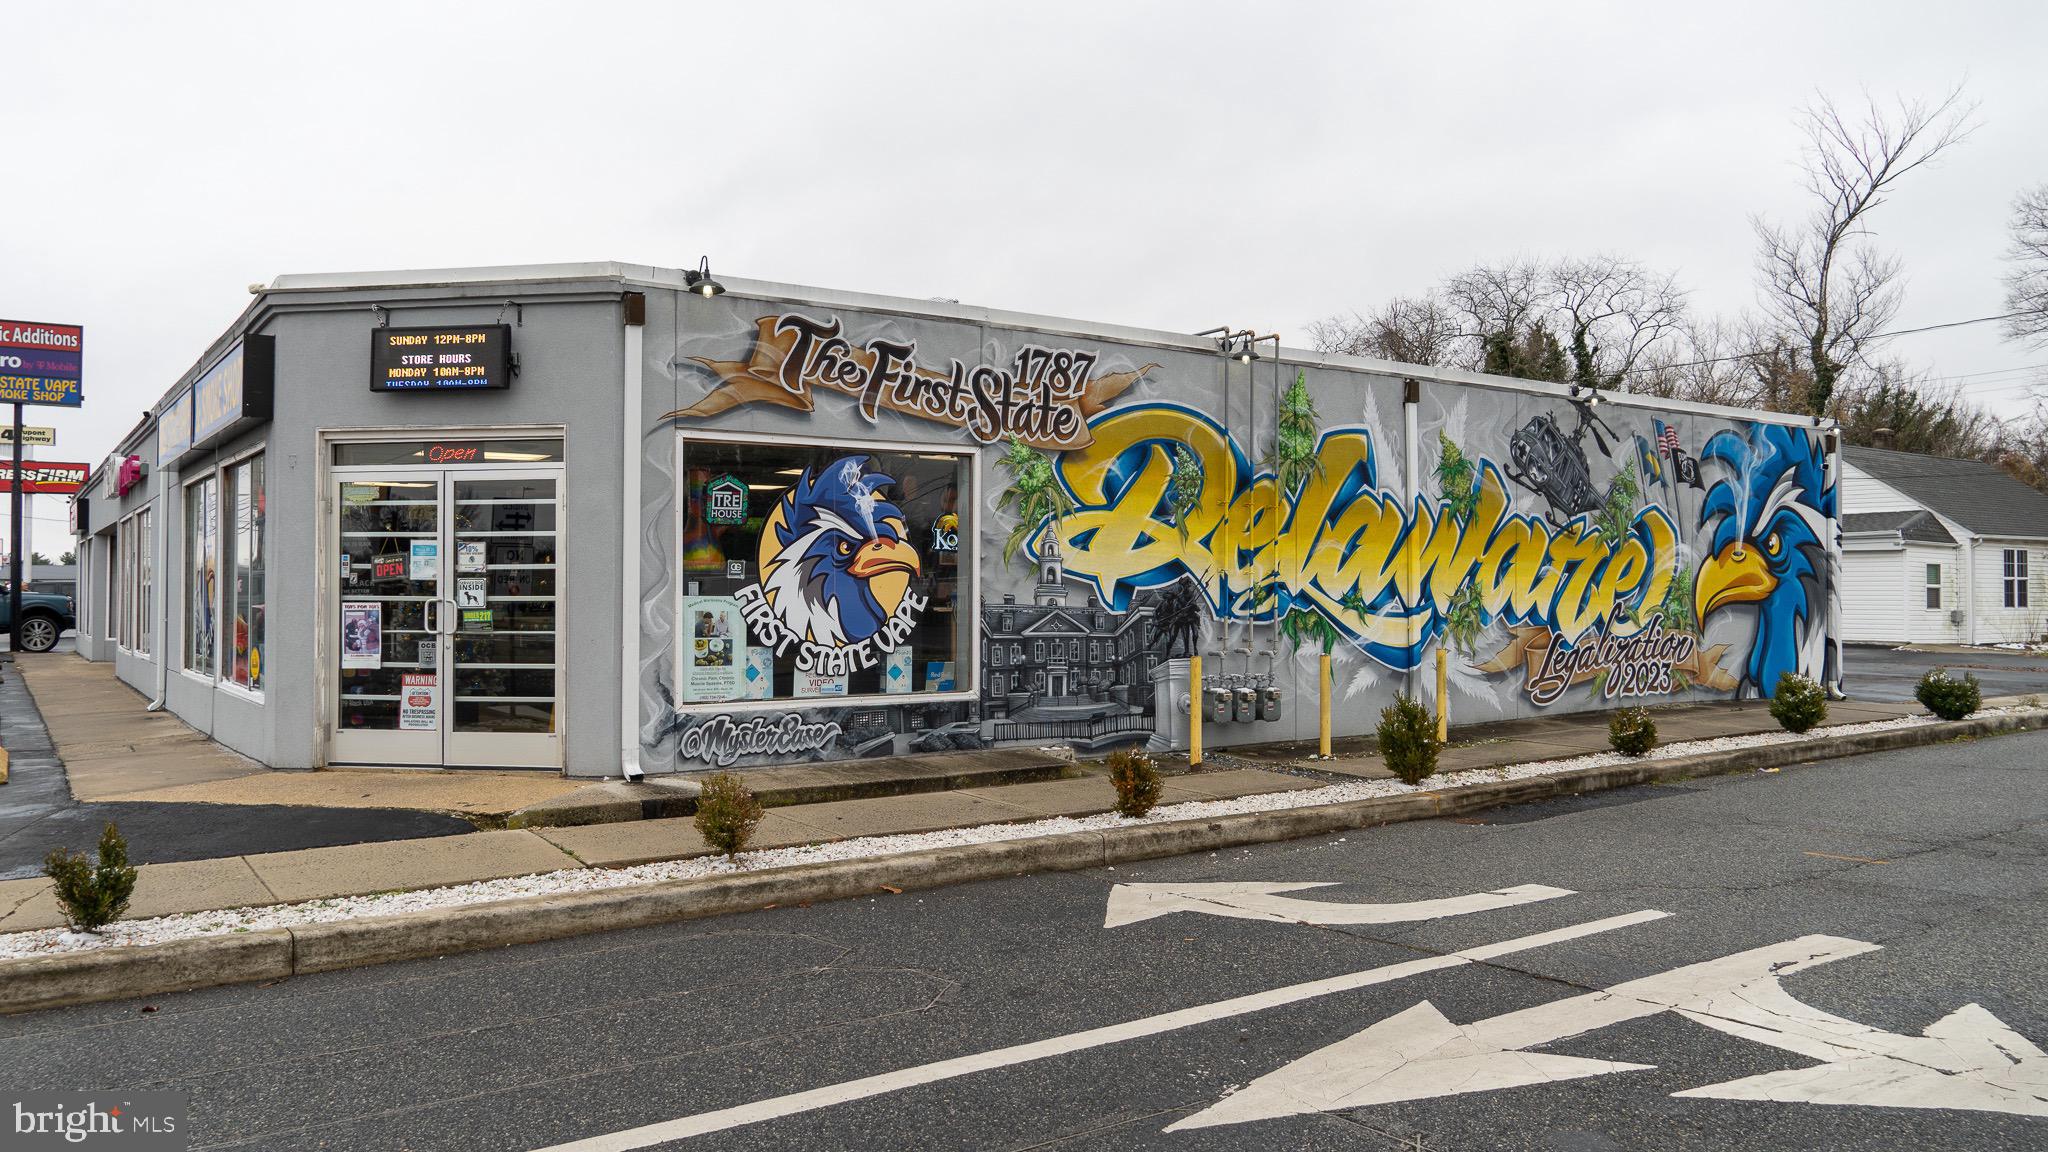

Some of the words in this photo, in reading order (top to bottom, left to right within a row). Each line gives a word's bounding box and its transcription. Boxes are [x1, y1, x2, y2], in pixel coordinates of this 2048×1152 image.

[12, 327, 78, 347] Additions
[390, 335, 428, 346] SUNDAY
[434, 333, 486, 344] 12PM-8PM
[401, 355, 433, 365] STORE
[439, 353, 472, 364] HOURS
[388, 368, 427, 378] MONDAY
[775, 312, 868, 394] The
[859, 338, 971, 424] First
[964, 365, 1083, 445] State
[1013, 343, 1099, 399] 1787
[0, 376, 40, 391] STATE
[45, 378, 78, 393] VAPE
[33, 390, 65, 402] SHOP
[429, 444, 477, 463] Open
[715, 494, 740, 507] TRE
[711, 509, 743, 518] HOUSE
[934, 528, 958, 550] Ko
[1024, 402, 1681, 672] Delaware
[376, 562, 403, 577] OPEN
[734, 583, 800, 658] FIRST
[795, 637, 879, 676] STATE
[872, 586, 929, 655] VAPE
[1528, 600, 1697, 707] Legalization
[1621, 661, 1673, 698] 2023
